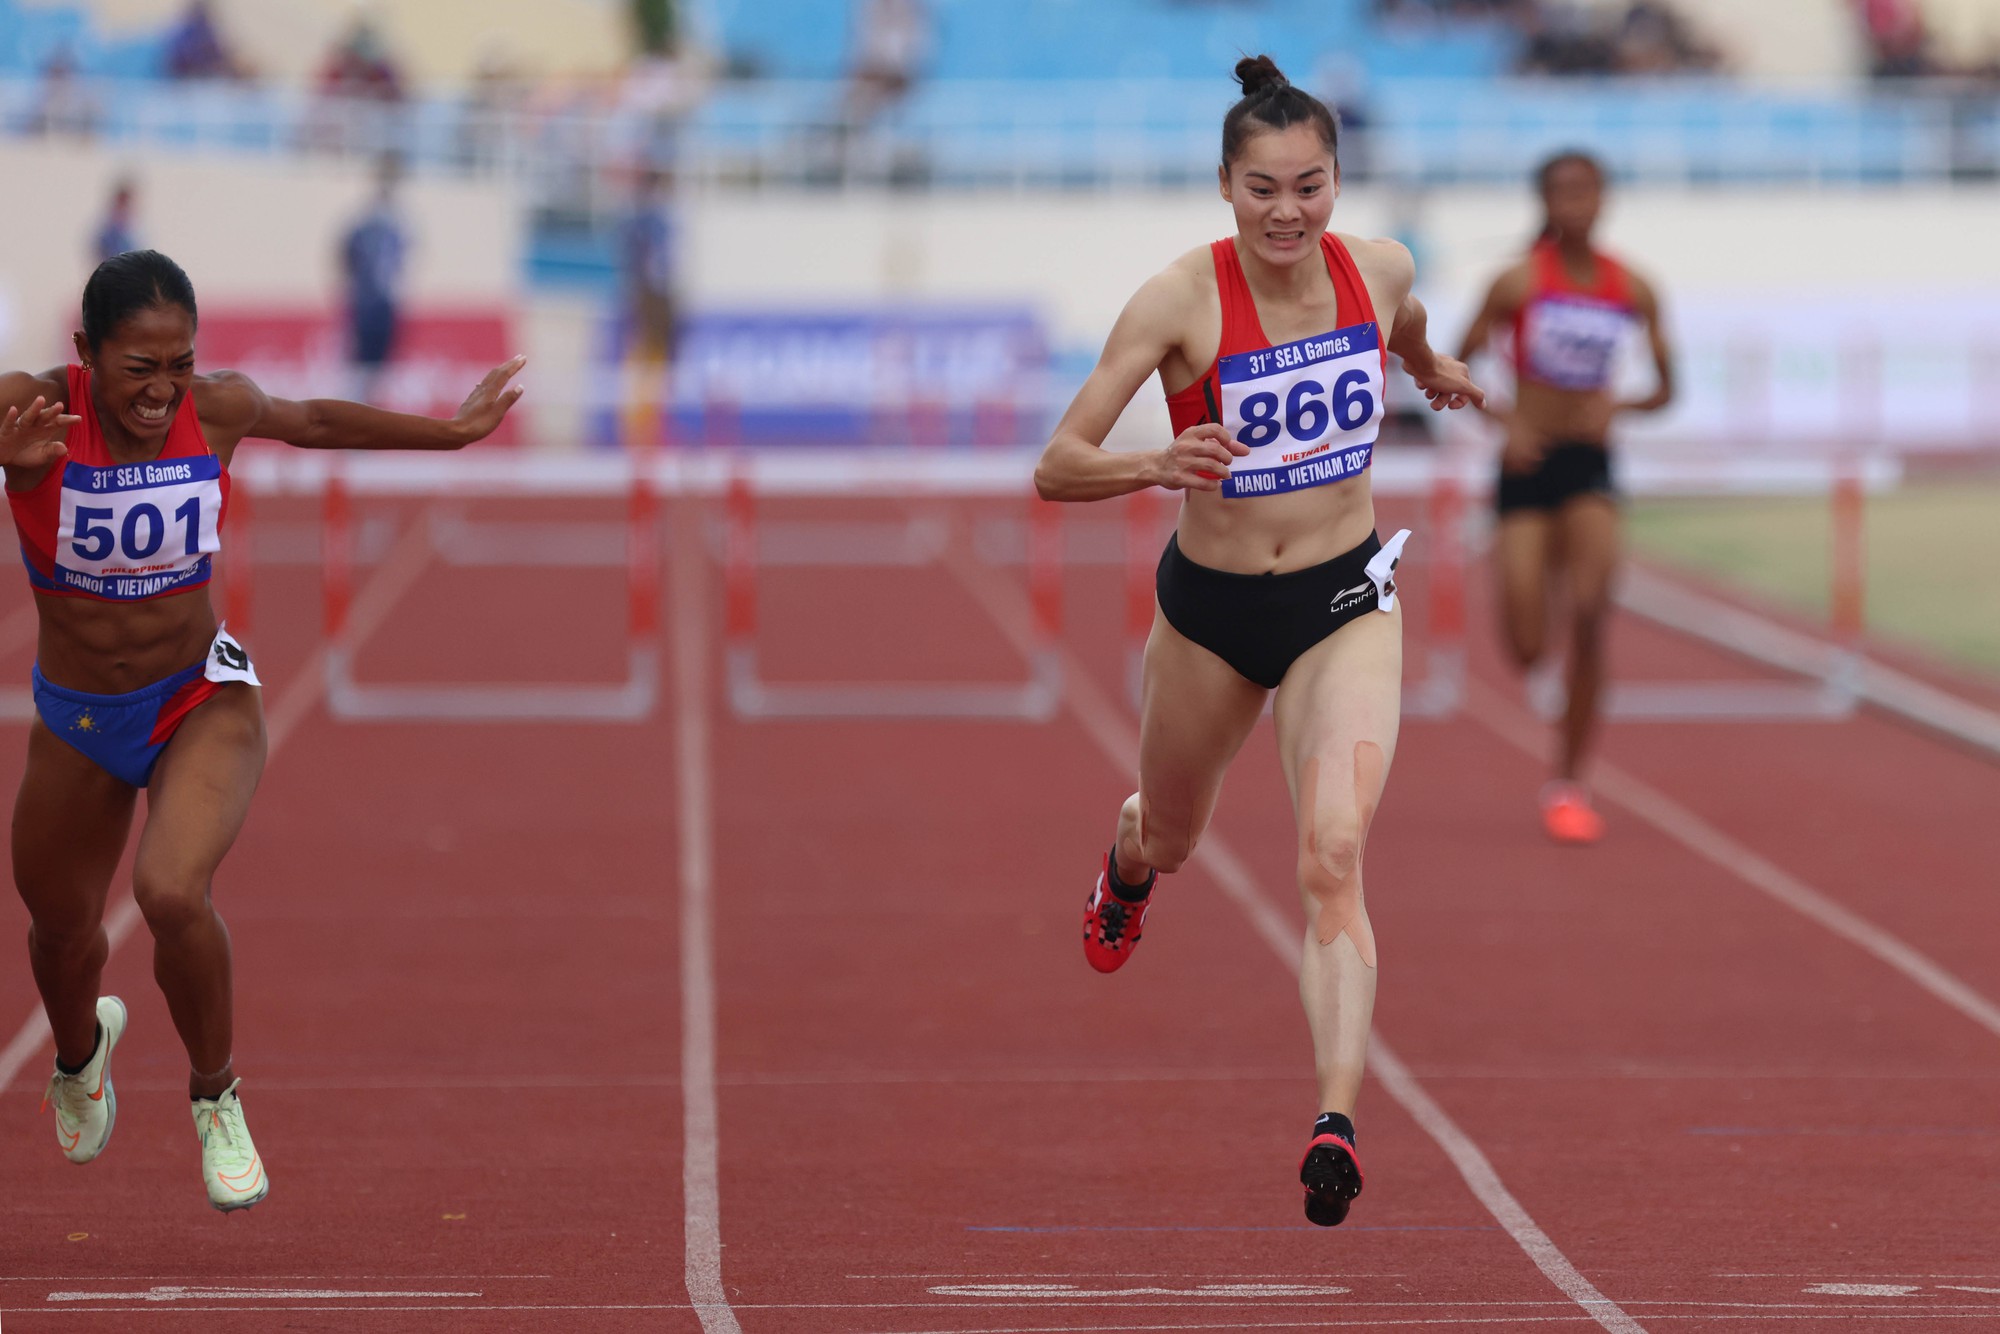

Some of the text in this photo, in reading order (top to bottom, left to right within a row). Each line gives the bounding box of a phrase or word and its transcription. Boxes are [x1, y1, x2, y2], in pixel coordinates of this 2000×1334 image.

[1275, 345, 1304, 368] SEA
[1304, 336, 1350, 361] Games
[1236, 368, 1374, 448] 866
[1281, 443, 1330, 463] VIETNAM
[116, 466, 143, 487] SEA
[145, 464, 192, 484] Games
[1234, 472, 1277, 493] HANOI
[1288, 455, 1343, 486] VIETNAM
[71, 496, 200, 561] 501
[65, 571, 104, 593] HANOI
[101, 563, 174, 575] PHILIPPINES
[1330, 586, 1376, 613] LI-NING
